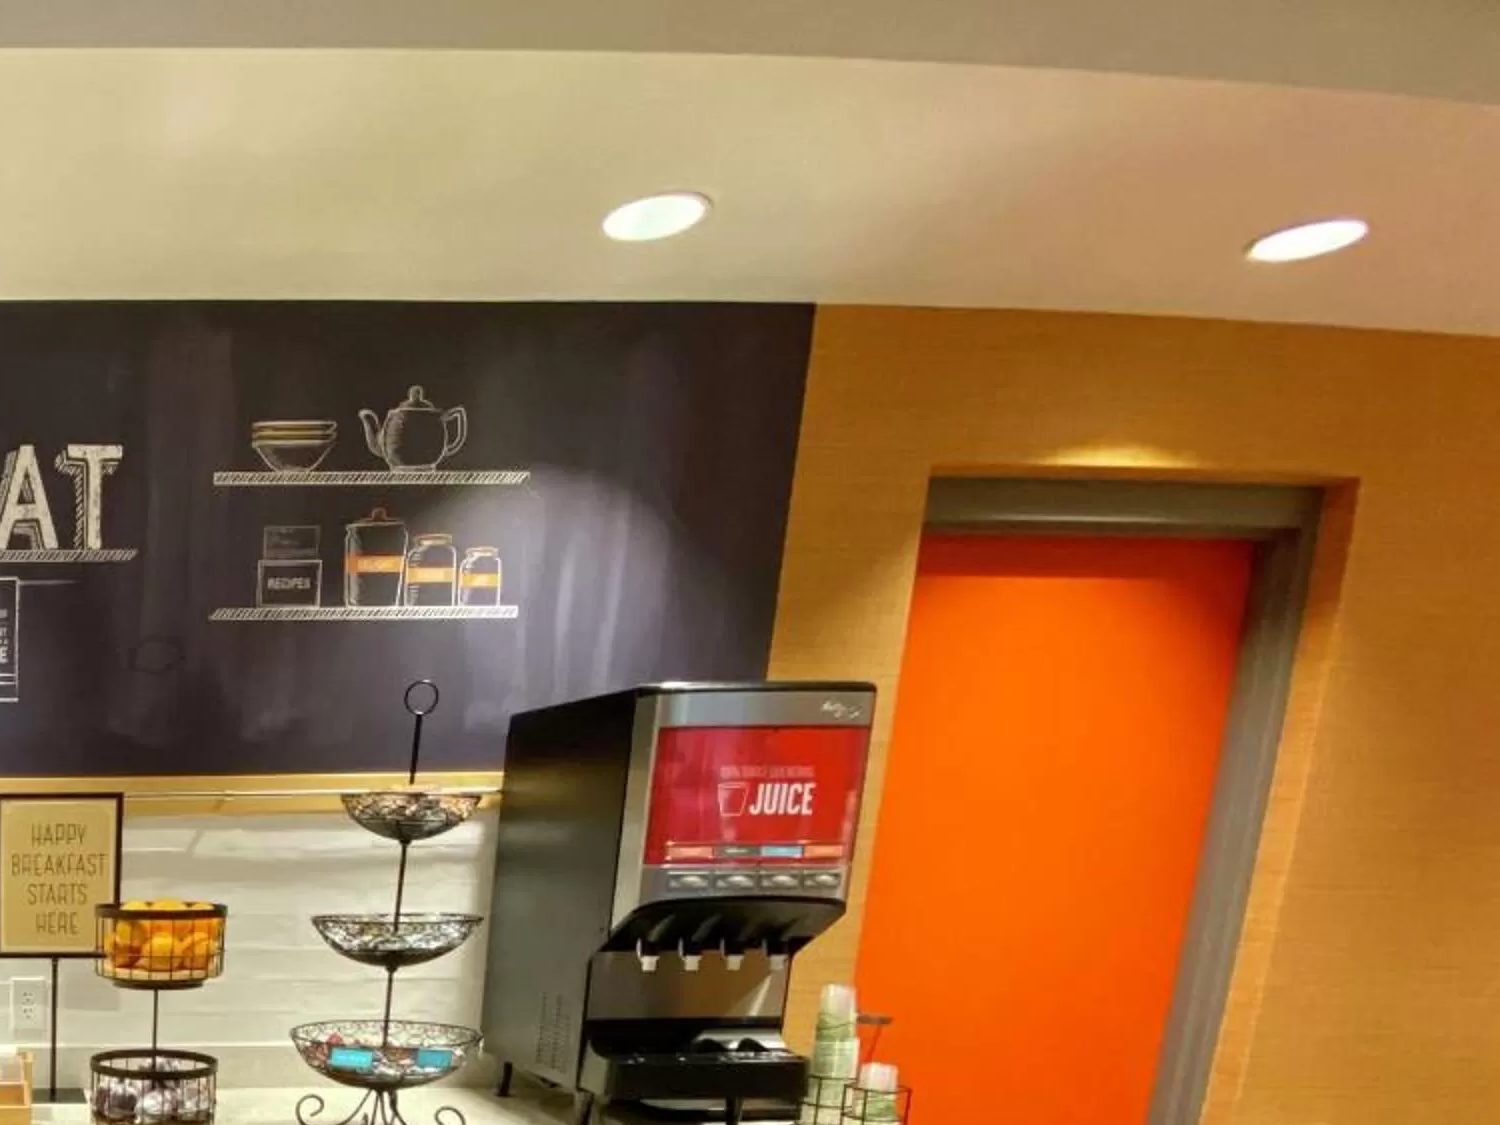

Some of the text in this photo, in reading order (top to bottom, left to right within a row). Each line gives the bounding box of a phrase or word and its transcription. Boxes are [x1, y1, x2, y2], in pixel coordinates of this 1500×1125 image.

[749, 782, 817, 816] JUICE
[30, 822, 88, 848] HAPPY
[11, 853, 109, 877] BREAKFAST
[26, 883, 88, 906] STARTS
[35, 911, 80, 935] HERE
